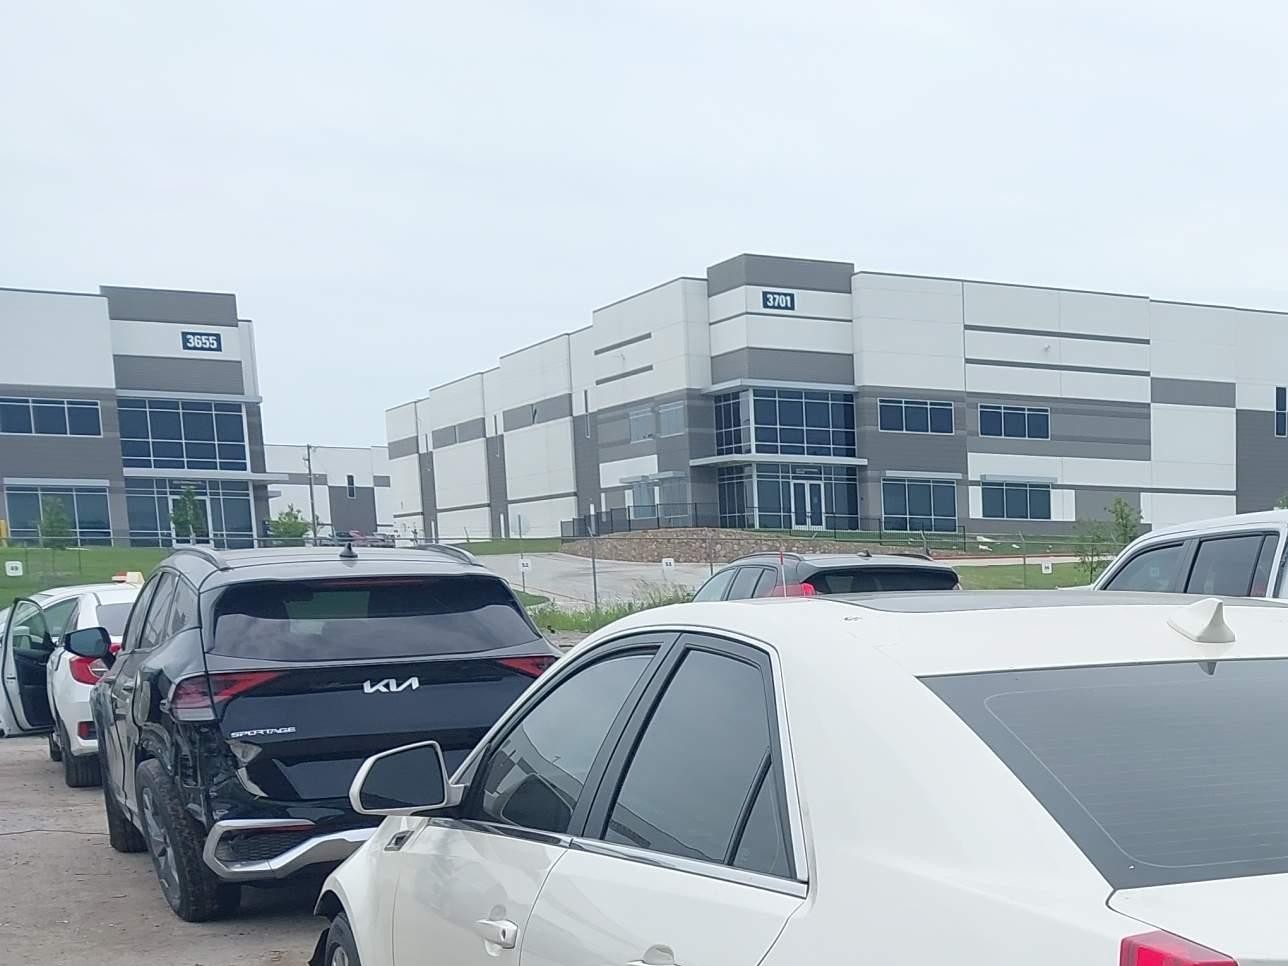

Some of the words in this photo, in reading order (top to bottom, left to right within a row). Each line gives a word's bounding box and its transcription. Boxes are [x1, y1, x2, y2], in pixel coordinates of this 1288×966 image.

[766, 293, 791, 308] 3701
[186, 334, 218, 349] 3655
[363, 677, 420, 693] KIA
[230, 727, 296, 738] SPORTAGE
